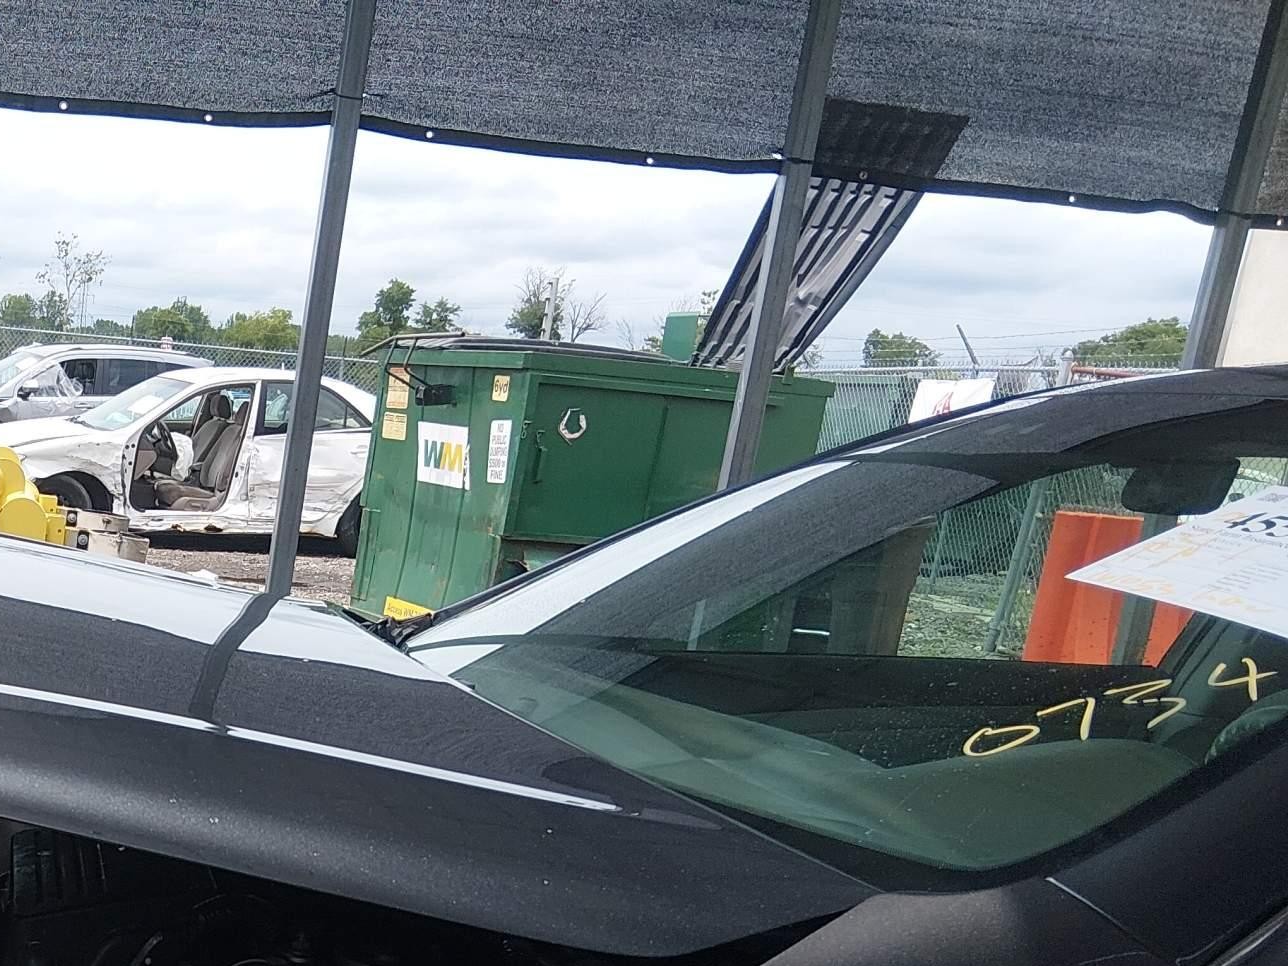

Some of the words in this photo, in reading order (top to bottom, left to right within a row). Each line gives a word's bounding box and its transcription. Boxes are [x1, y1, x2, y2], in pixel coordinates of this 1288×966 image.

[494, 379, 509, 396] 6yd
[423, 438, 464, 474] WM
[489, 469, 504, 480] FINE
[962, 657, 1279, 757] 0734
